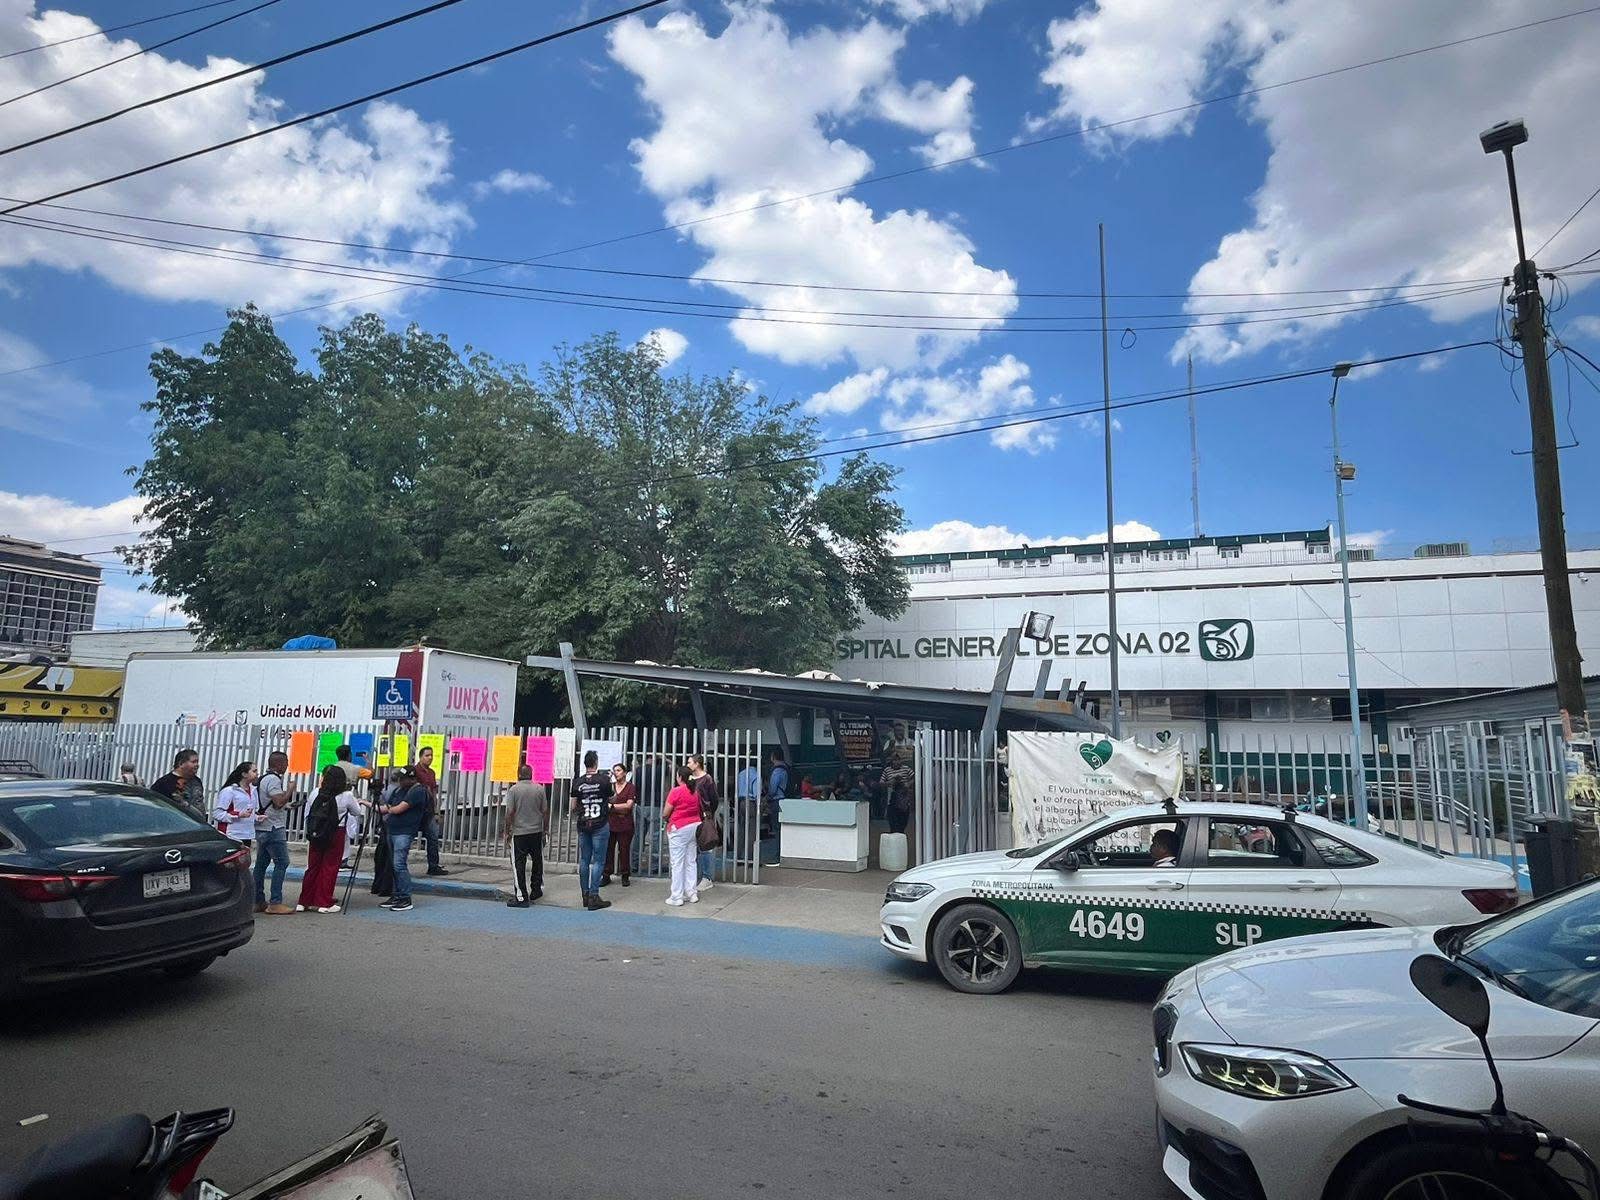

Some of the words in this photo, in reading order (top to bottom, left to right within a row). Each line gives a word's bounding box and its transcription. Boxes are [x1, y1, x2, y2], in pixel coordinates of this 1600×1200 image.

[836, 638, 910, 660] SPITAL
[1036, 634, 1070, 656] DE
[1076, 632, 1154, 655] ZONA
[1158, 631, 1191, 653] 02
[260, 703, 301, 718] Unidad
[304, 704, 337, 719] Móvil
[1048, 785, 1057, 793] El
[1059, 786, 1118, 797] Voluntariado
[1054, 796, 1084, 804] ofrece
[1045, 805, 1086, 816] albergue
[971, 879, 991, 888] ZONA
[992, 881, 1054, 890] METROPOLITANA
[1069, 909, 1145, 942] 4649
[1215, 922, 1263, 947] SLP
